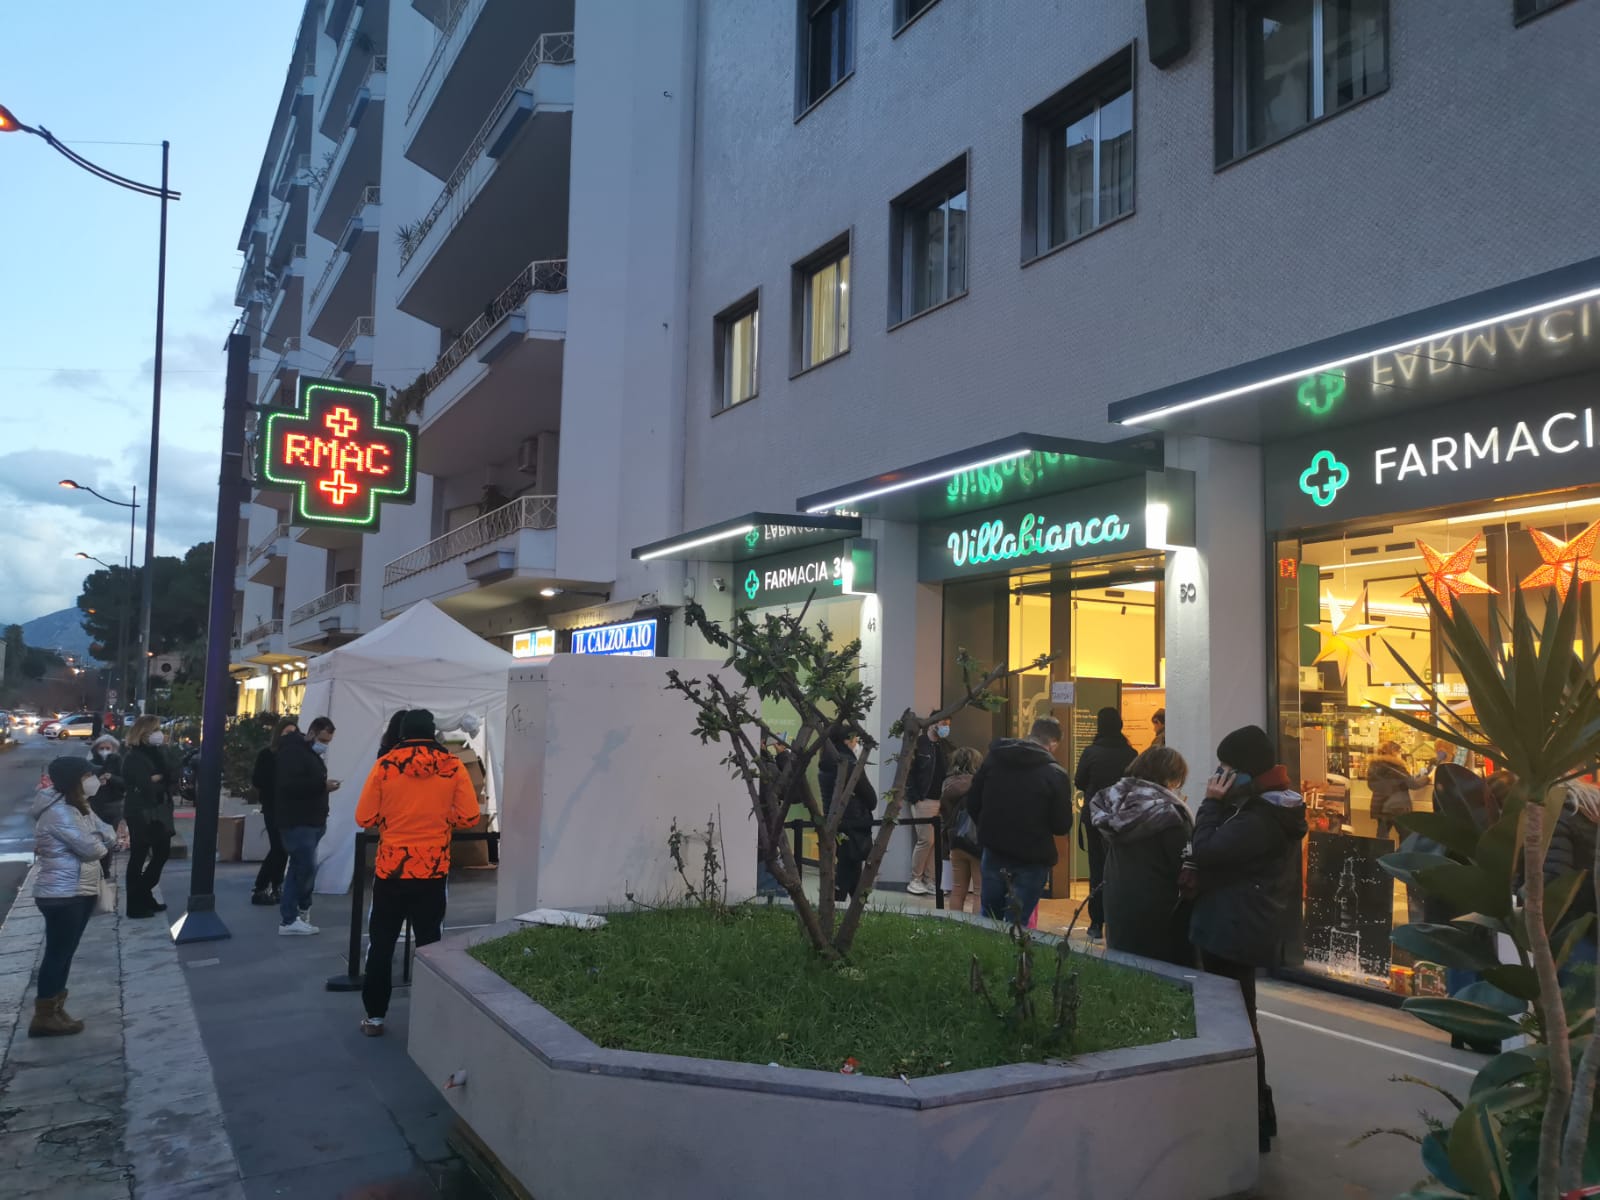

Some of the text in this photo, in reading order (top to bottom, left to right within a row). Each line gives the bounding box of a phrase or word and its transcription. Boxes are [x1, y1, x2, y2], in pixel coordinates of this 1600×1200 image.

[285, 434, 391, 474] RMAC
[1374, 408, 1600, 485] FARMACI
[947, 513, 1130, 567] Villabianca
[764, 561, 828, 591] FARMACIA
[576, 633, 586, 653] IL
[587, 624, 651, 652] CALZOLAIO
